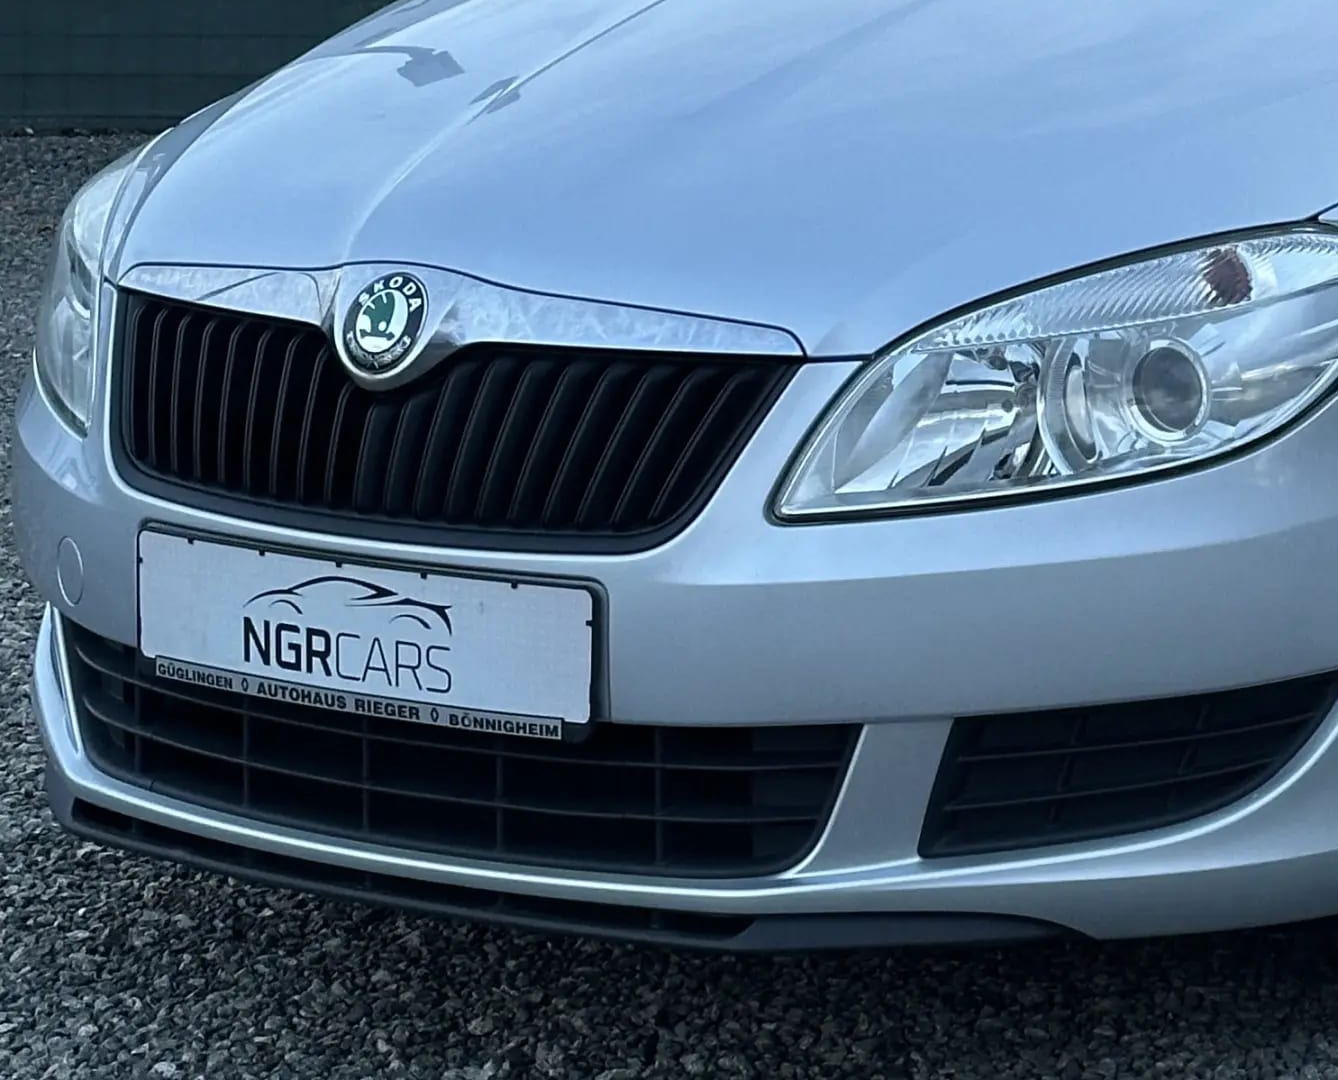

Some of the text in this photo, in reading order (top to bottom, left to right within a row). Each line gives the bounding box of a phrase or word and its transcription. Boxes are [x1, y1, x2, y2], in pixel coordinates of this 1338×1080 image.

[243, 617, 452, 694] NGRCARS
[257, 682, 348, 710] AUTOHAUS
[354, 698, 420, 721] RIEGER
